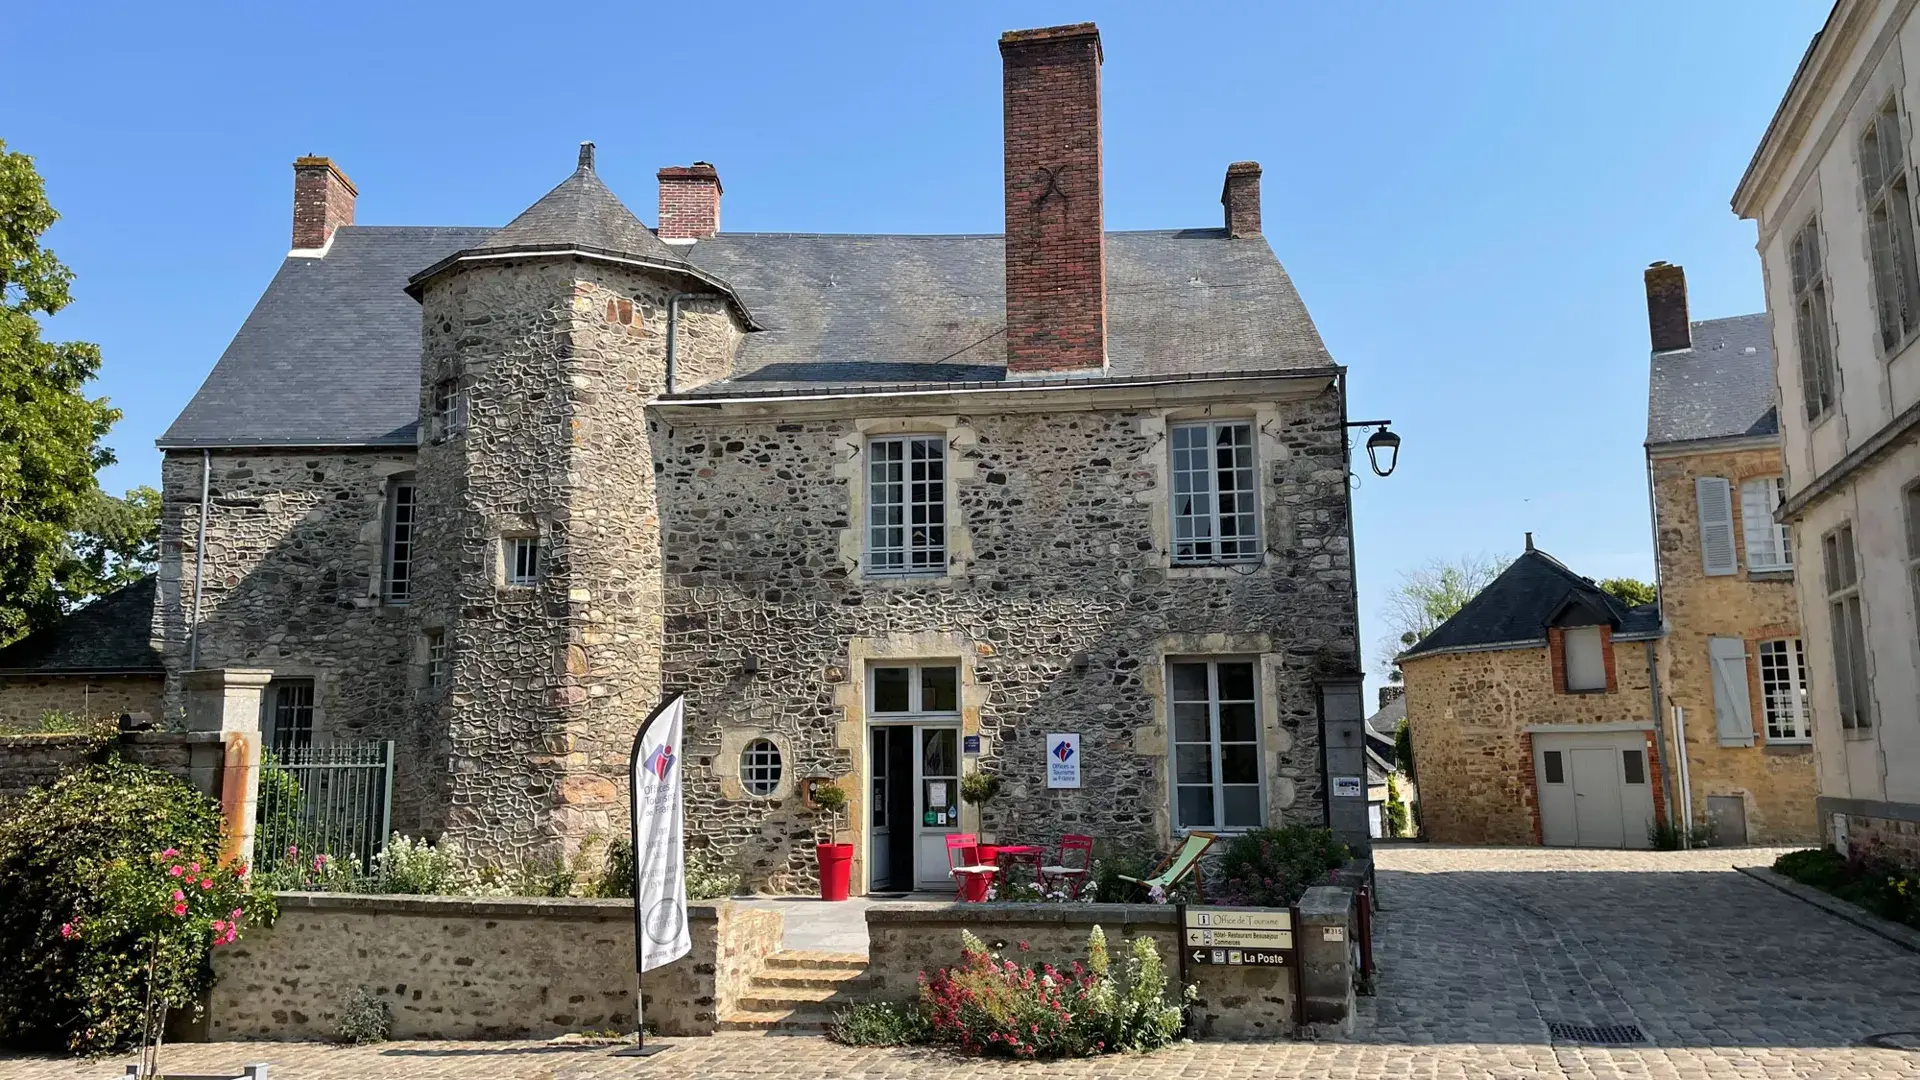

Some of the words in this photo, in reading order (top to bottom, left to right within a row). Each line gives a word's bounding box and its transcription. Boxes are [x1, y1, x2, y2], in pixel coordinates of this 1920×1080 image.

[1213, 914, 1236, 926] Office
[1237, 915, 1245, 924] de
[1245, 915, 1279, 926] Tourisme
[1213, 938, 1241, 946] Commerces
[1244, 952, 1256, 963] La
[1257, 953, 1284, 964] Poste
